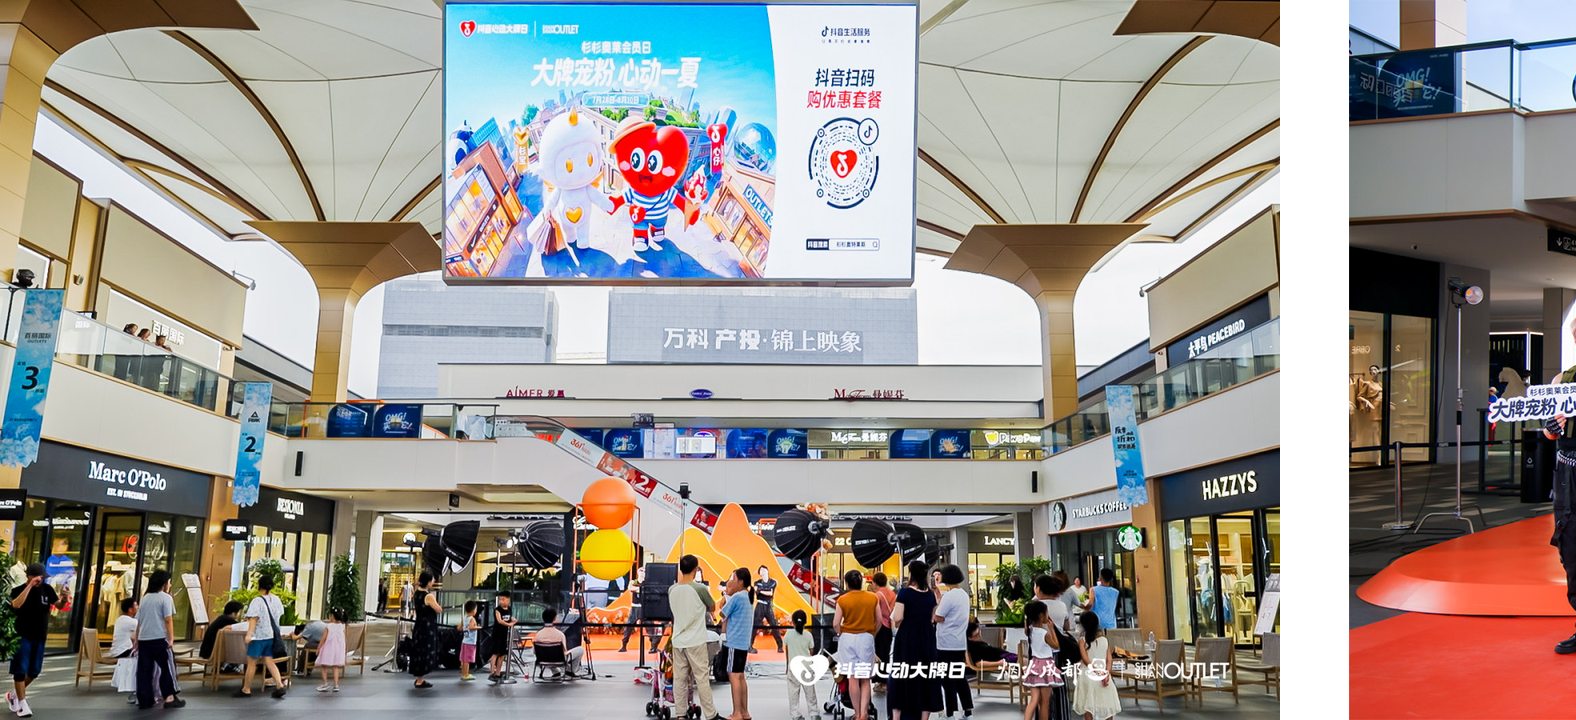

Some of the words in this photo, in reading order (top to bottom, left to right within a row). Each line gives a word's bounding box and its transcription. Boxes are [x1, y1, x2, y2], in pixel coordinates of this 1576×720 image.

[830, 28, 871, 37] 抖音生活服务
[581, 41, 652, 54] 杉杉奥莱会员日
[530, 57, 615, 88] 大牌宠粉
[617, 57, 702, 90] 心动一夏
[815, 68, 875, 87] 抖音扫码
[1396, 67, 1431, 88] OMG!
[806, 90, 882, 109] 购优惠套餐
[152, 320, 186, 346] 百丽国际
[663, 327, 709, 349] 万科
[715, 328, 862, 353] 产投·锦上映象
[1188, 335, 1208, 358] 太平鸟
[1208, 319, 1246, 347] PEACEBIRD
[21, 366, 39, 390] 3
[1491, 397, 1558, 420] 大牌宠粉
[244, 436, 256, 453] 2
[88, 461, 125, 484] Marc
[128, 469, 167, 491] O'Polo
[1202, 470, 1258, 501] HAZZYS
[1072, 503, 1104, 519] STARBUCKS
[834, 537, 845, 546] 22
[984, 536, 1015, 546] LANCY
